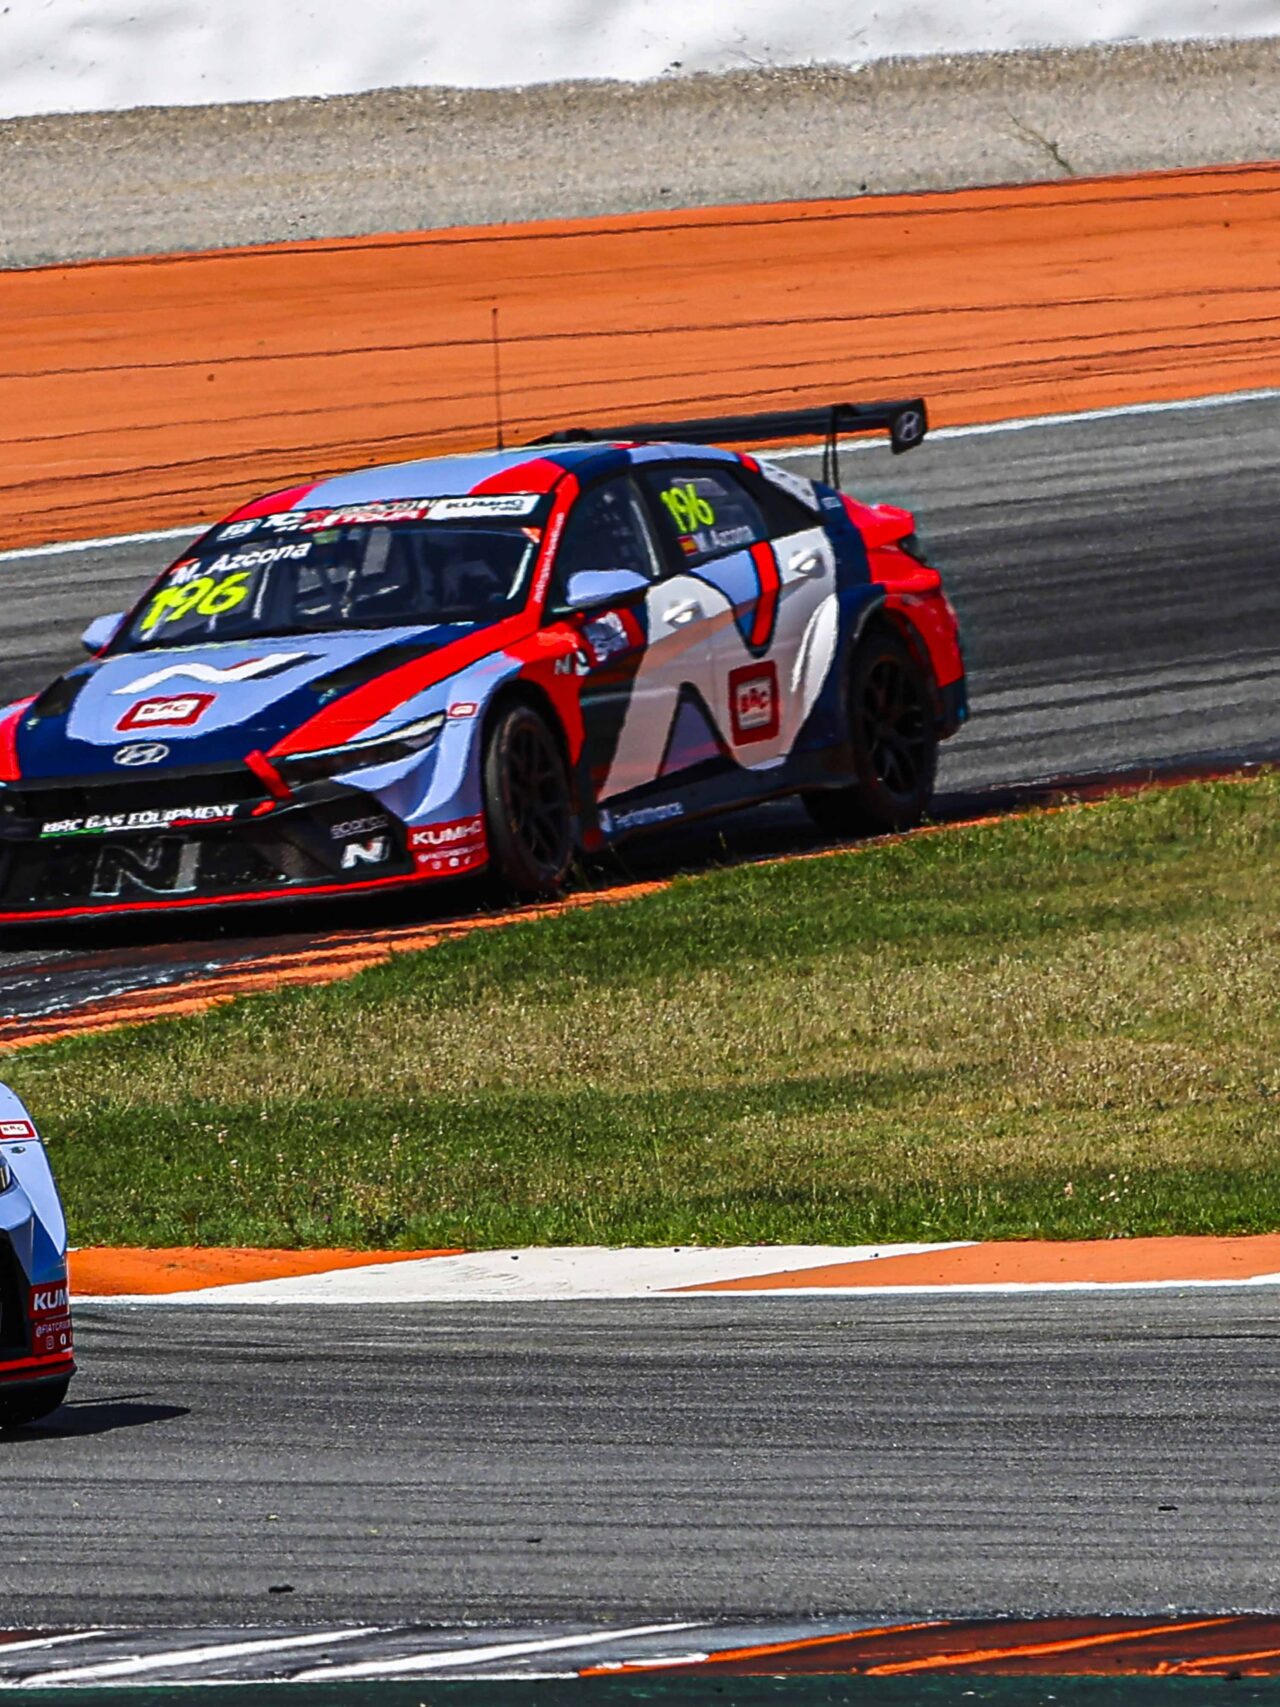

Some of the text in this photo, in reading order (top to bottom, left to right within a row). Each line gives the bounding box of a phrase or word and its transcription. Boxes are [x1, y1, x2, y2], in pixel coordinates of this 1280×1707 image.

[660, 484, 715, 534] 196
[203, 542, 313, 576] Azcona
[140, 572, 252, 631] 196
[41, 804, 240, 833] BRC GAS EQUIPMENT
